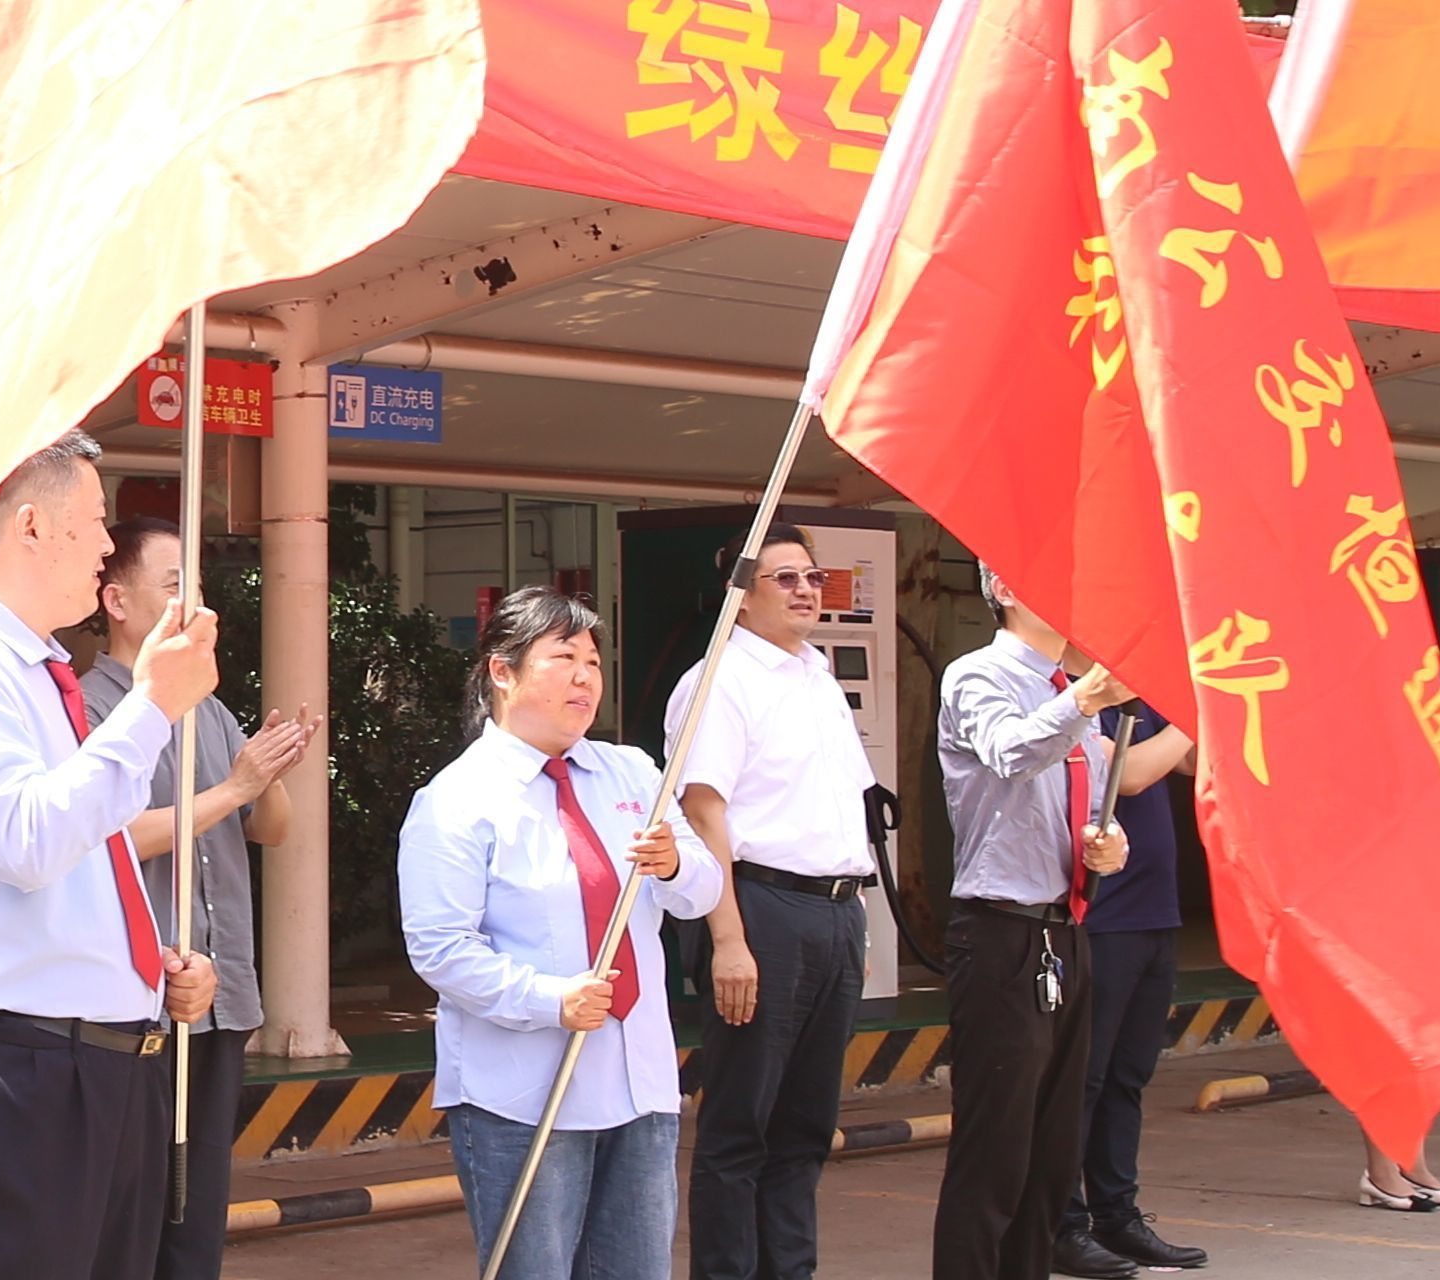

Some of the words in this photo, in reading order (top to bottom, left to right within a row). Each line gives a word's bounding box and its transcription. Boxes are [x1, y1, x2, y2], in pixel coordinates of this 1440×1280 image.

[371, 384, 435, 410] 直流充电
[370, 411, 386, 425] DC
[389, 412, 435, 431] Charging
